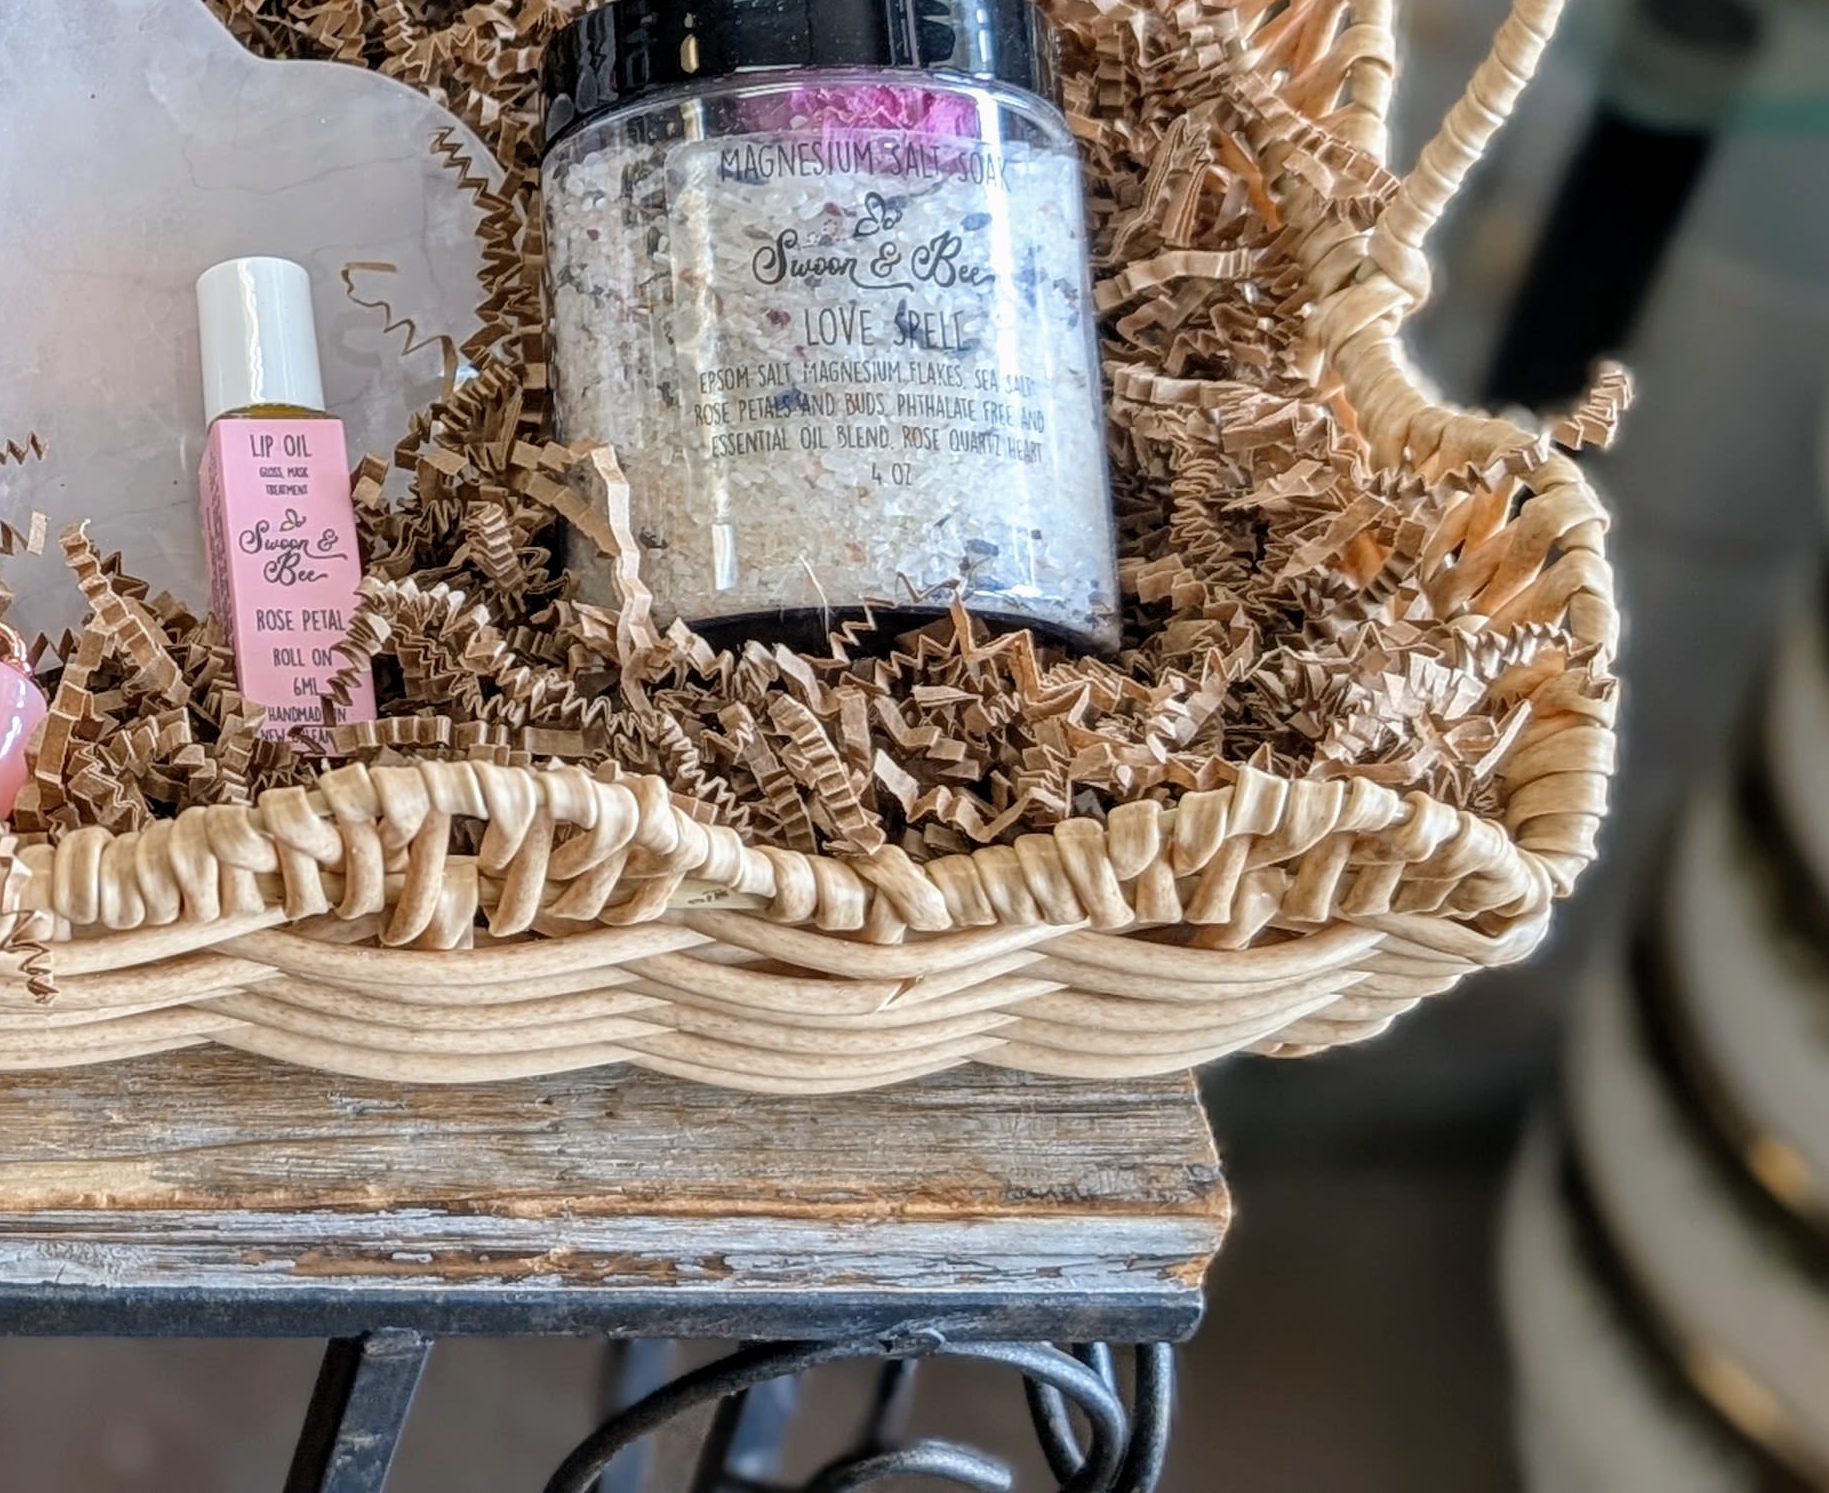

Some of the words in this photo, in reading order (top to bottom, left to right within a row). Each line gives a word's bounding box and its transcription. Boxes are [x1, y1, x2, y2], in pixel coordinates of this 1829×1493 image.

[720, 139, 874, 183] MAGNESIUM
[889, 143, 941, 179] SALT
[957, 151, 1012, 194] SOAK
[752, 228, 915, 292] Swoon
[870, 240, 903, 280] &
[910, 229, 996, 289] Bee
[803, 304, 875, 347] LOVE
[892, 308, 969, 352] SPELL
[698, 366, 750, 395] EPSOM
[802, 359, 902, 384] MAGNESIUM
[974, 368, 999, 393] SEA
[693, 401, 730, 428] ROSE
[737, 394, 792, 423] PETALS
[799, 392, 836, 418] AND
[896, 393, 976, 422] PHTHALATE
[982, 400, 1014, 428] FREE
[1020, 406, 1046, 434] AND
[249, 434, 274, 458] LIP
[283, 434, 313, 458] OIL
[711, 427, 791, 459] ESSENTIAL
[800, 426, 828, 450] OIL
[902, 424, 941, 452] ROSE
[948, 427, 1002, 458] QUARTZ
[1007, 436, 1044, 464] HEART
[287, 466, 309, 478] MASK
[871, 462, 883, 487] 4
[891, 462, 913, 487] OZ
[265, 483, 309, 496] TREATMENT
[238, 519, 348, 561] Swoon
[317, 528, 340, 553] &
[263, 549, 329, 587] Bee
[255, 608, 295, 632] ROSE
[301, 608, 347, 632] PETAL
[273, 647, 306, 667] ROLL
[311, 647, 333, 667] ON
[293, 676, 320, 696] 6ML
[267, 705, 322, 722] HANDMAD
